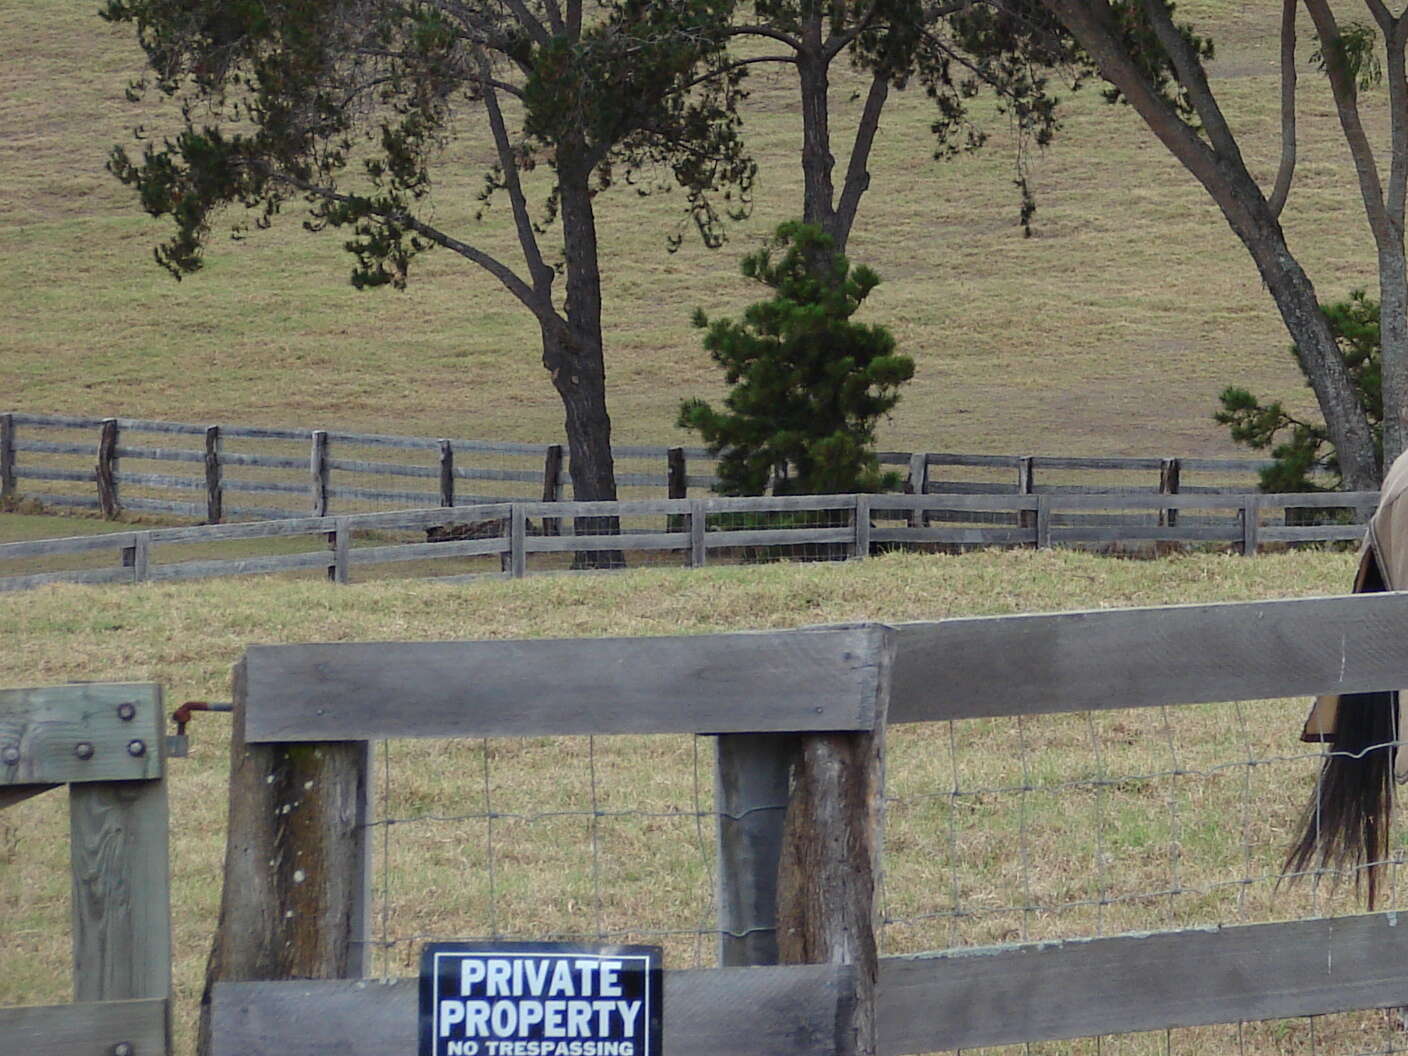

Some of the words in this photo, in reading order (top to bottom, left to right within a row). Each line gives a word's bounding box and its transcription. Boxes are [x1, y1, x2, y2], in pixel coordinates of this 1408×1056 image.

[460, 959, 623, 997] PRIVATE
[439, 1000, 643, 1038] PROPERTY
[447, 1041, 479, 1056] NO
[485, 1041, 635, 1056] TRESPASSING
